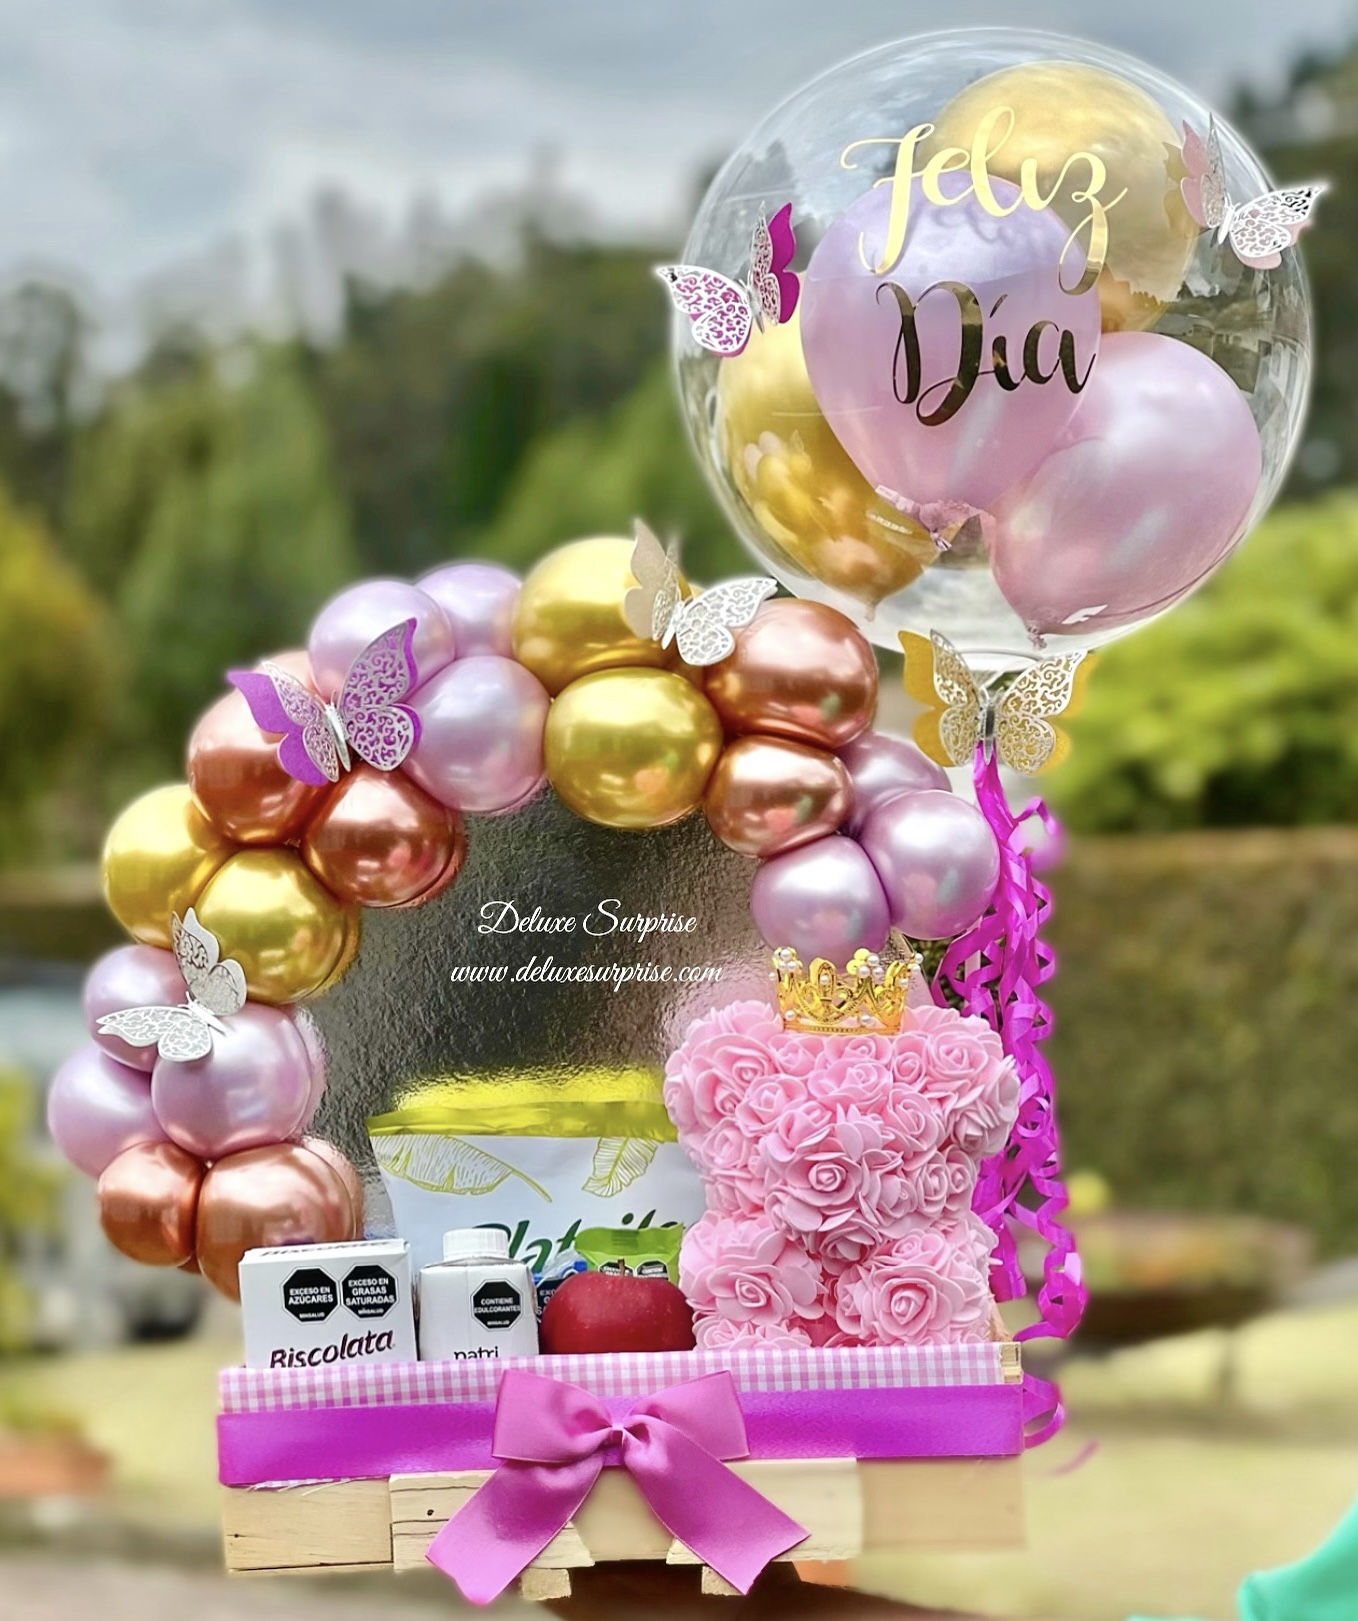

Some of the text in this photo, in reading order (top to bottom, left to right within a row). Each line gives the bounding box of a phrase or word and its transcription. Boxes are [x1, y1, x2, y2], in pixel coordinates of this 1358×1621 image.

[840, 105, 1128, 295] Feliz
[875, 280, 1097, 427] Día
[347, 1277, 389, 1287] EXCESO EN
[289, 1286, 331, 1296] EXCESO EN
[351, 1286, 387, 1297] GRASAS
[345, 1295, 395, 1306] SATURADAS
[480, 1297, 514, 1306] CONTIENE
[473, 1304, 521, 1314] EDULCORANTES
[270, 1329, 394, 1369] Biscolata
